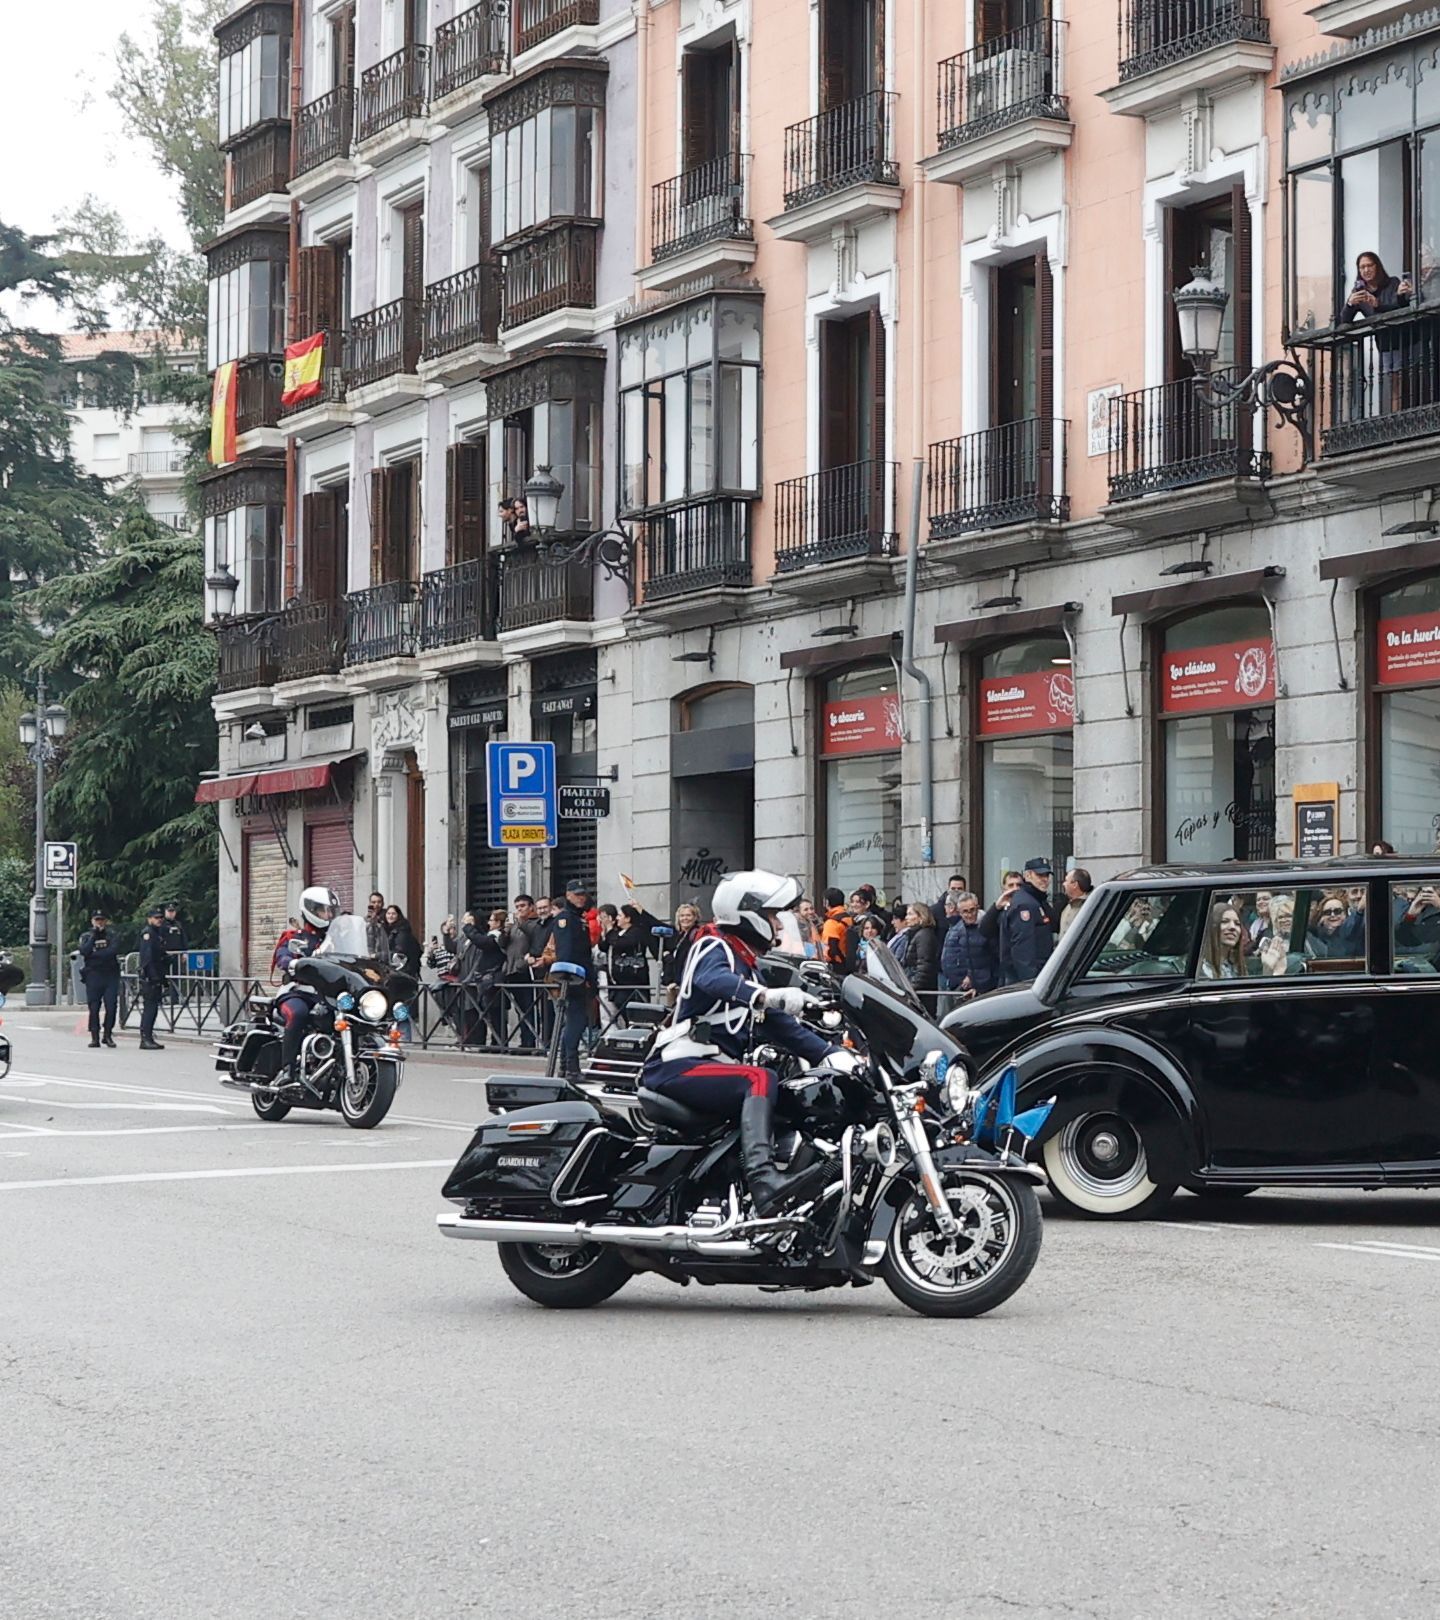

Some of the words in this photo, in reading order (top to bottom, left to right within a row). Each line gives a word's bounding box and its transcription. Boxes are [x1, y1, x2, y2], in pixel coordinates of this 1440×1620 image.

[1387, 632, 1400, 646] De
[1401, 629, 1412, 645] la
[1170, 664, 1183, 681] Los
[1184, 660, 1216, 676] clásicos
[509, 752, 536, 789] P
[562, 788, 606, 798] MARKET
[574, 799, 596, 807] OLD
[564, 808, 606, 817] MADRID
[502, 828, 520, 839] PLAZA
[522, 828, 545, 839] ORIENTE
[1174, 814, 1207, 846] Tapas
[1213, 809, 1220, 829] y
[48, 845, 68, 870] P
[498, 1156, 525, 1167] GUARDIA
[525, 1156, 540, 1167] REAL
